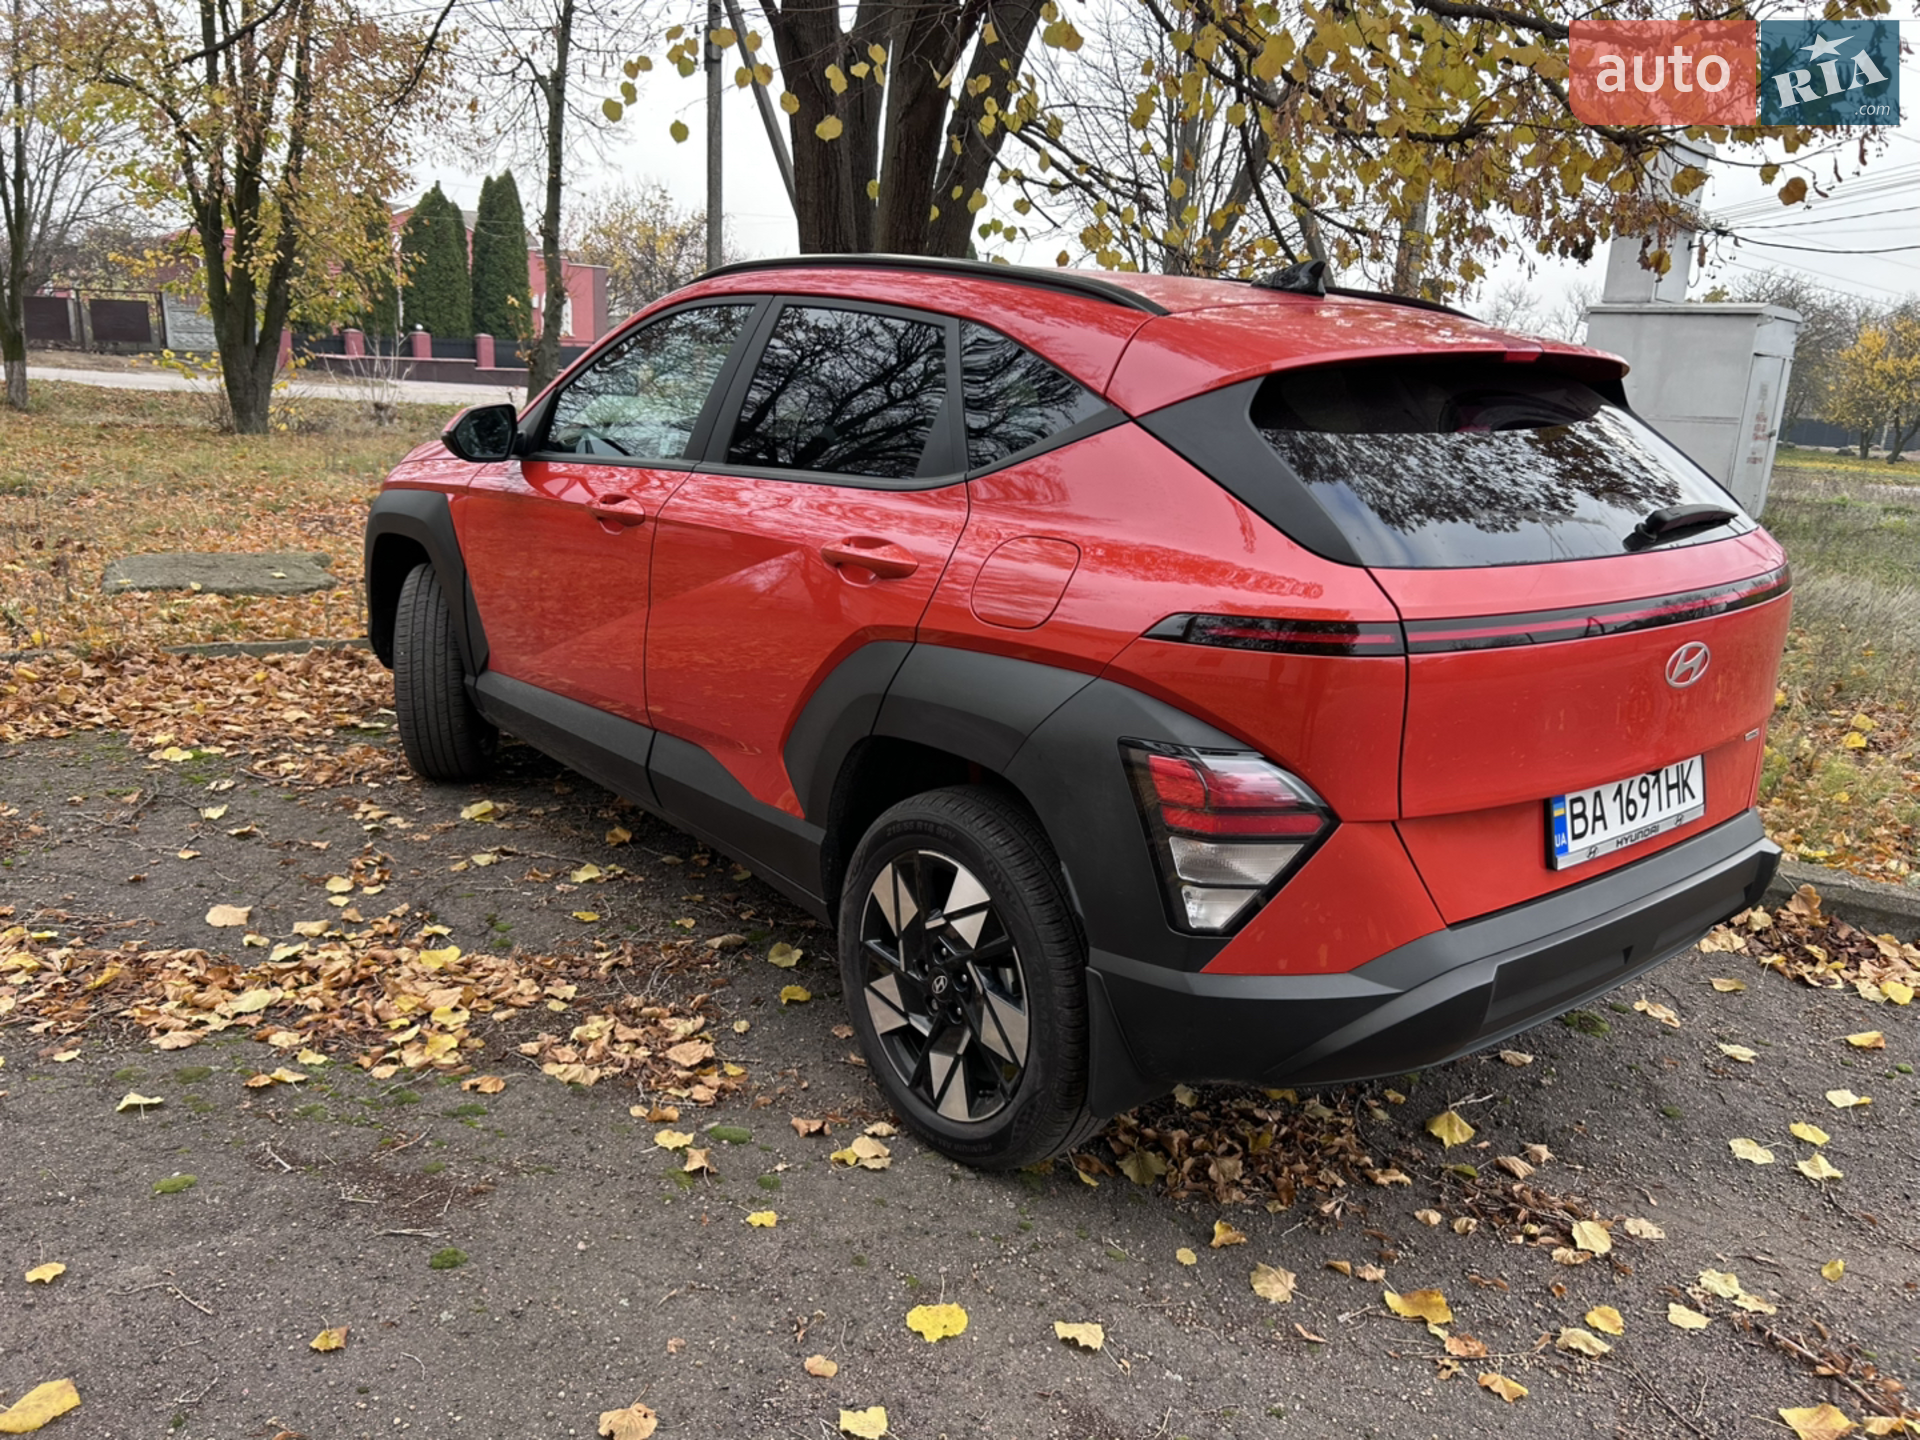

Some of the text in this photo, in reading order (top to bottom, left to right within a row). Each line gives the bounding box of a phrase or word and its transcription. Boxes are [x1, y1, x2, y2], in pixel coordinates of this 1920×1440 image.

[1569, 790, 1608, 841] BA
[1554, 832, 1568, 848] UA
[1615, 824, 1660, 848] HYUNDAI
